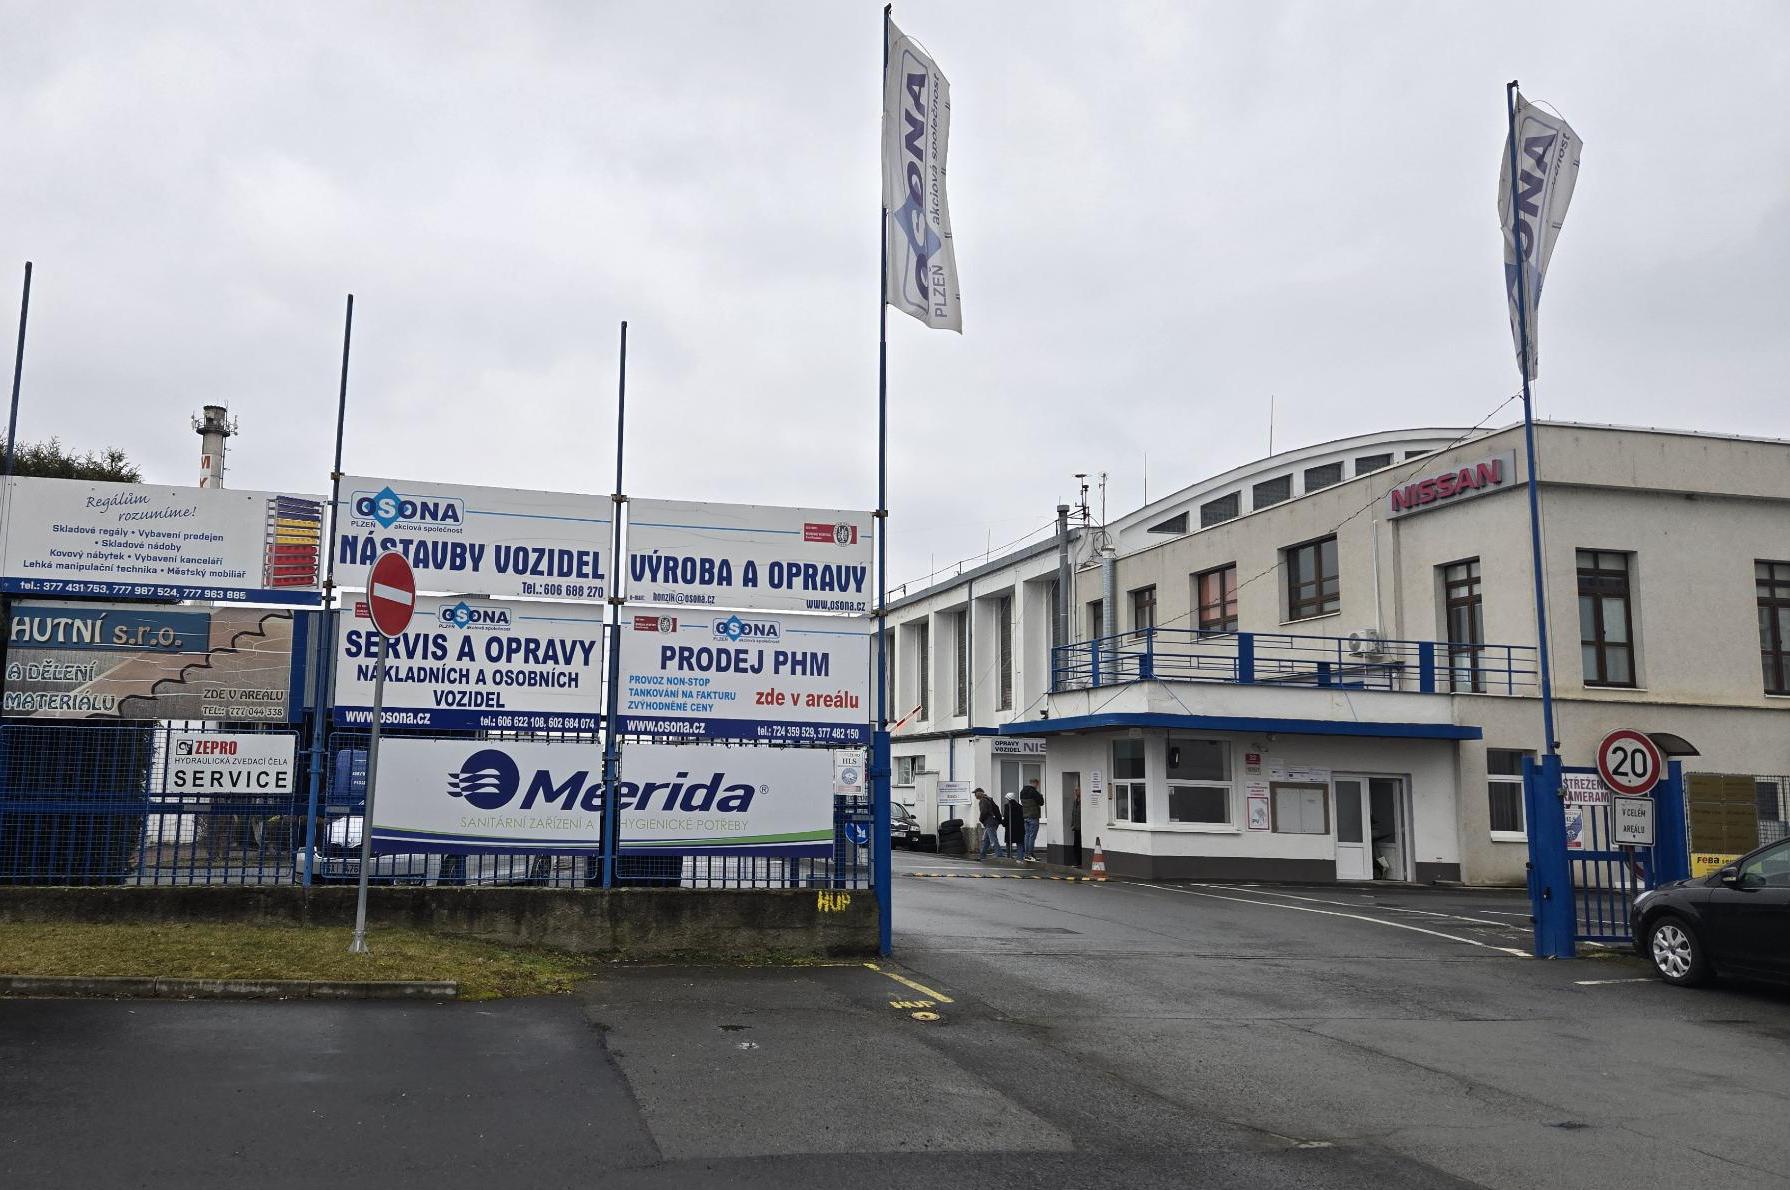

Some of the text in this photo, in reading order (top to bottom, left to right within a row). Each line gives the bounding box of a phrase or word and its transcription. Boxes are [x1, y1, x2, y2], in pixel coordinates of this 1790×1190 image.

[932, 158, 942, 226] akciová
[930, 264, 947, 318] PLZEŇ
[1391, 459, 1503, 512] NISSAN
[86, 491, 150, 514] Regálům
[356, 497, 460, 523] OSONA
[118, 506, 197, 522] rozumíme!
[52, 524, 224, 543] Skladové regály Vybavení prodejen
[351, 520, 463, 535] PLZEŇ akciová společnost
[101, 539, 182, 554] Skladové nádoby
[50, 548, 223, 566] Kovový nábytek Vybavení kanceláří
[494, 544, 605, 580] VOZIDEL
[23, 559, 246, 579] Lehká manipulační technika Městský mobiliář
[630, 550, 867, 593] VÝROBA A OPRAVY
[20, 581, 246, 601] tel.: 377 431 753, 777 987 524, 777 963 885
[522, 582, 604, 598] Tel.: 606 688 270
[806, 599, 866, 612] www.osona.cz
[442, 609, 509, 624] OSONA
[10, 612, 183, 646] HUTNÍ s.r.o.
[716, 622, 778, 637] OSONA
[345, 630, 596, 667] SERVIS A OPRAVY
[660, 645, 830, 677] PRODEJ PHM
[8, 660, 97, 681] A DĚLENÍ
[357, 660, 579, 689] NÁKLADNÍCH A OSOBNÍCH
[629, 676, 710, 686] PROVOZ NON-STOP
[4, 690, 115, 711] MATERIÁLU
[203, 688, 283, 700] ZDE V AREÁLU
[433, 690, 505, 708] VOZIDEL
[629, 687, 736, 700] TANKOVÁNÍ NA FAKTURU
[755, 688, 859, 709] zde v areálu
[229, 707, 247, 717] 777
[248, 707, 264, 717] 044
[266, 707, 283, 717] 338
[690, 703, 713, 712] CENY
[480, 716, 495, 727] tel.:
[498, 717, 513, 727] 606
[515, 717, 530, 727] 622
[549, 718, 563, 728] 602
[565, 719, 579, 728] 684
[580, 719, 594, 729] 074
[627, 720, 705, 735] www.osona.cz
[757, 727, 859, 740] tel.: 724 359 529, 377 482 150
[195, 740, 237, 755] ZEPRO
[1023, 742, 1047, 753] NIS
[174, 757, 288, 766] HYDRAULICKÁ ZVEDACÍ ČELA
[1611, 746, 1648, 778] 20
[174, 770, 288, 788] SERVICE
[1622, 808, 1628, 816] V
[460, 816, 529, 829] SANITÁRNÍ
[530, 817, 584, 831] ZAŘÍZENÍ
[586, 821, 595, 831] A
[696, 818, 748, 831] POTŘEBY
[1622, 824, 1645, 834] AREÁLU
[817, 890, 851, 912] HUP
